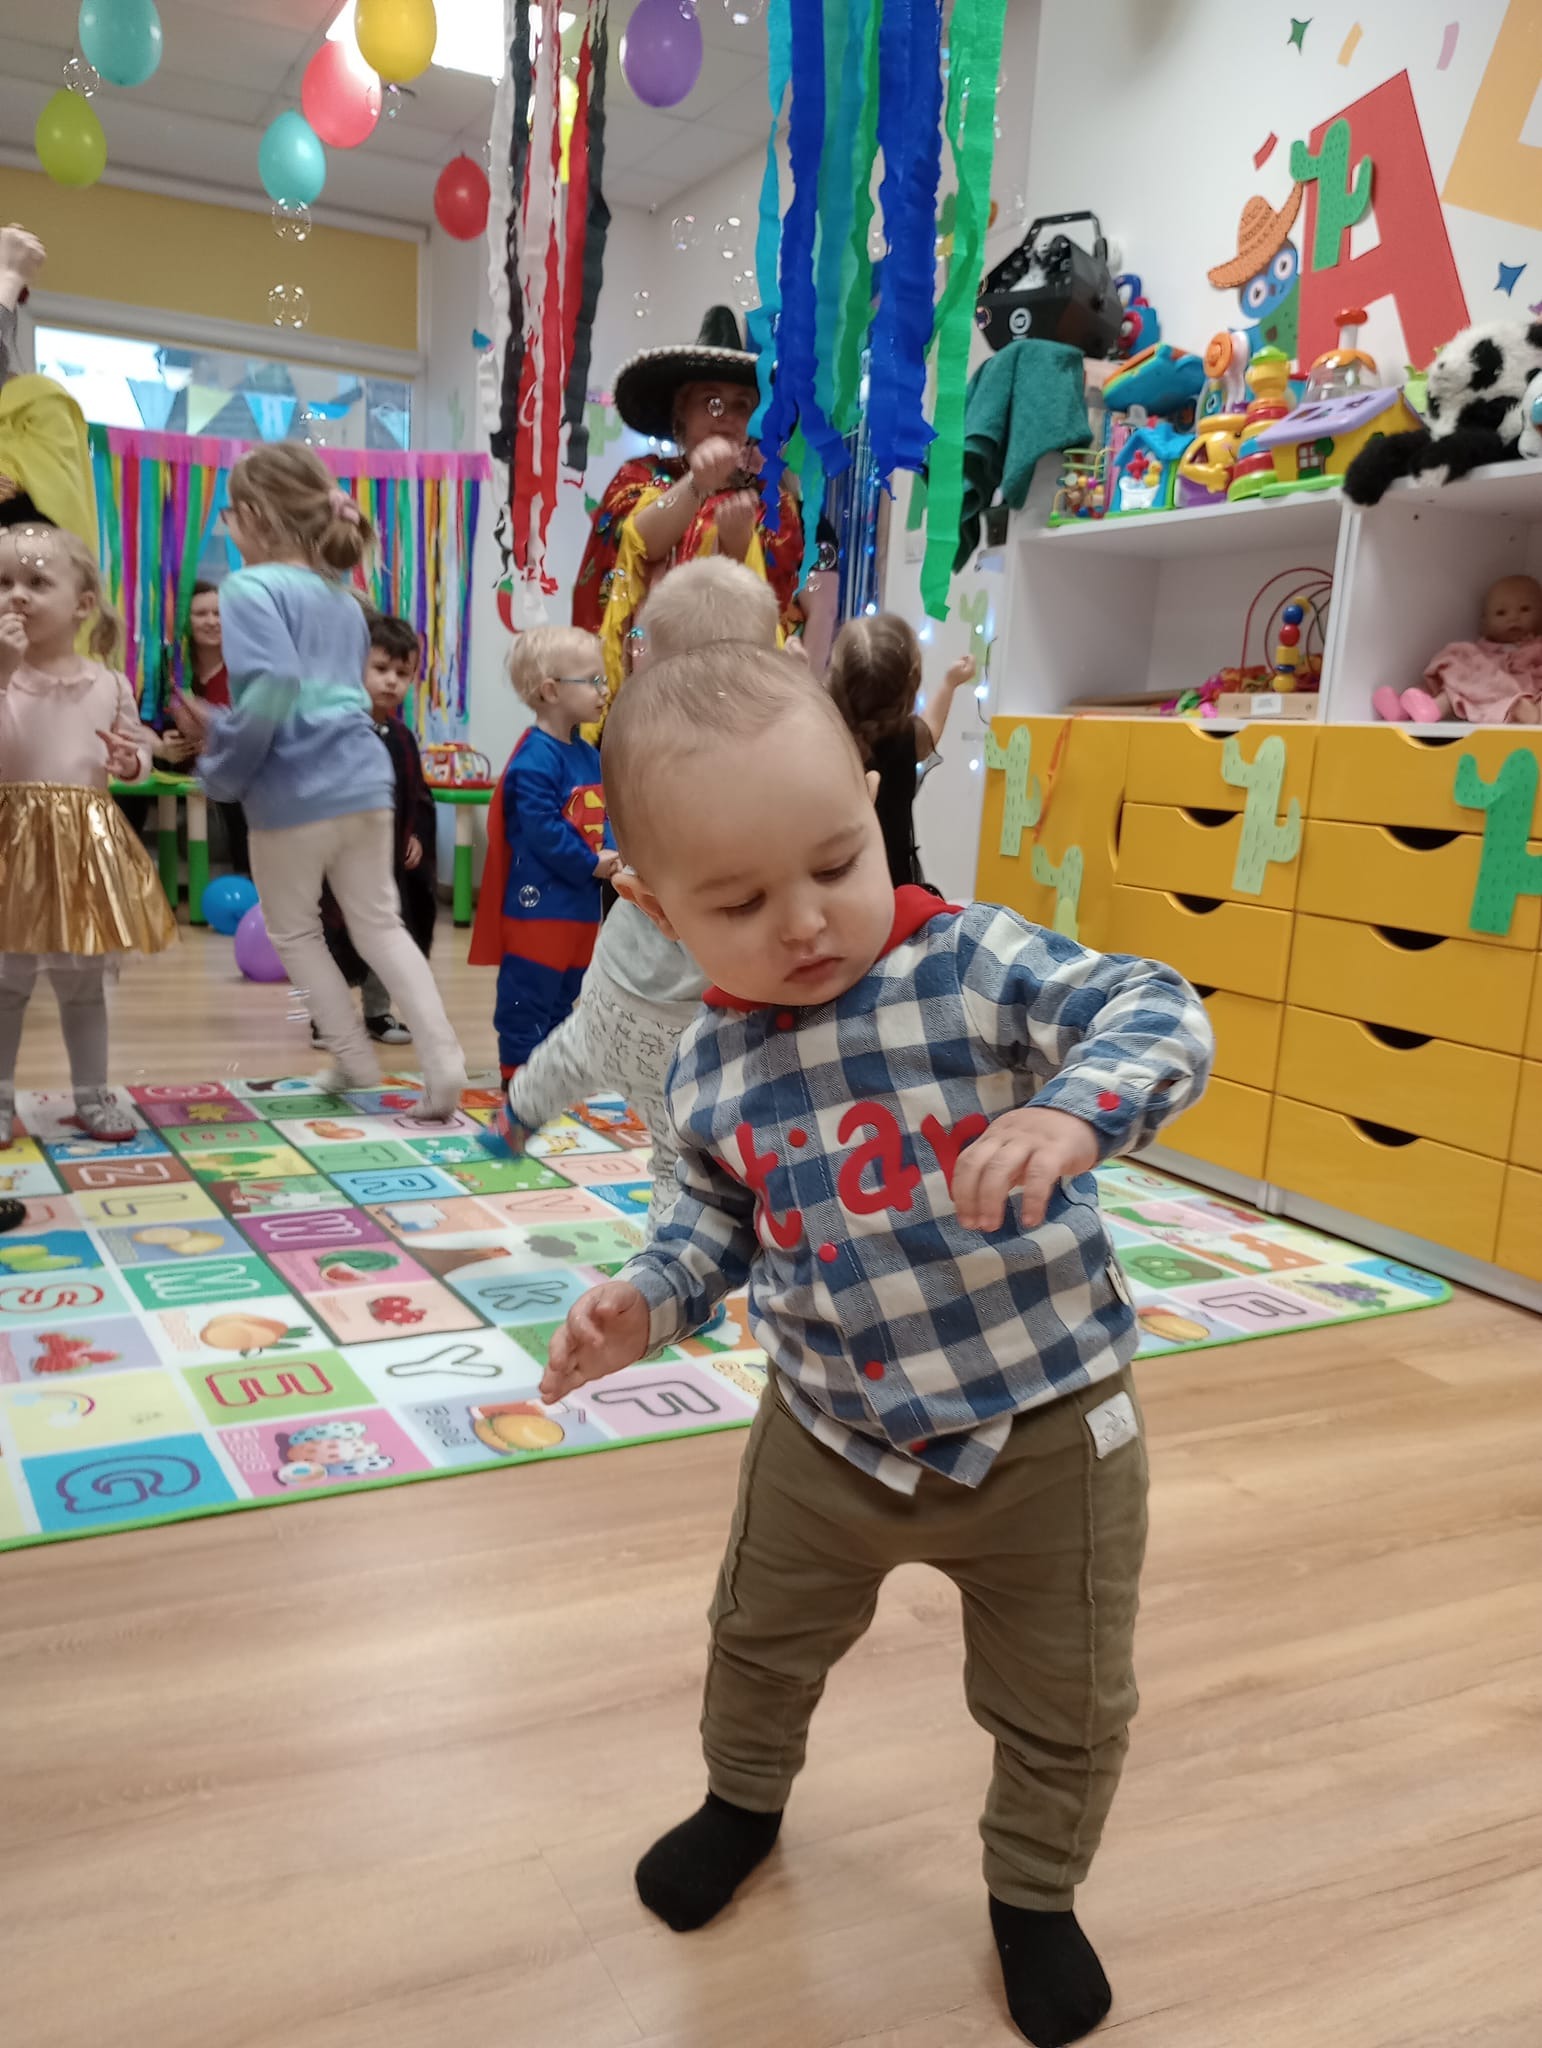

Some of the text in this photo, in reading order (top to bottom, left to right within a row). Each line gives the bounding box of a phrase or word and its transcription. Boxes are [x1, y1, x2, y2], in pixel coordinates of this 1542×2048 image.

[1291, 69, 1472, 381] A
[350, 1173, 436, 1196] R
[713, 1100, 990, 1250] tar
[505, 1194, 592, 1215] V
[0, 1282, 104, 1313] S
[386, 1345, 502, 1377] Y
[205, 1361, 334, 1408] E
[591, 1380, 720, 1417] F
[56, 1454, 200, 1514] G
